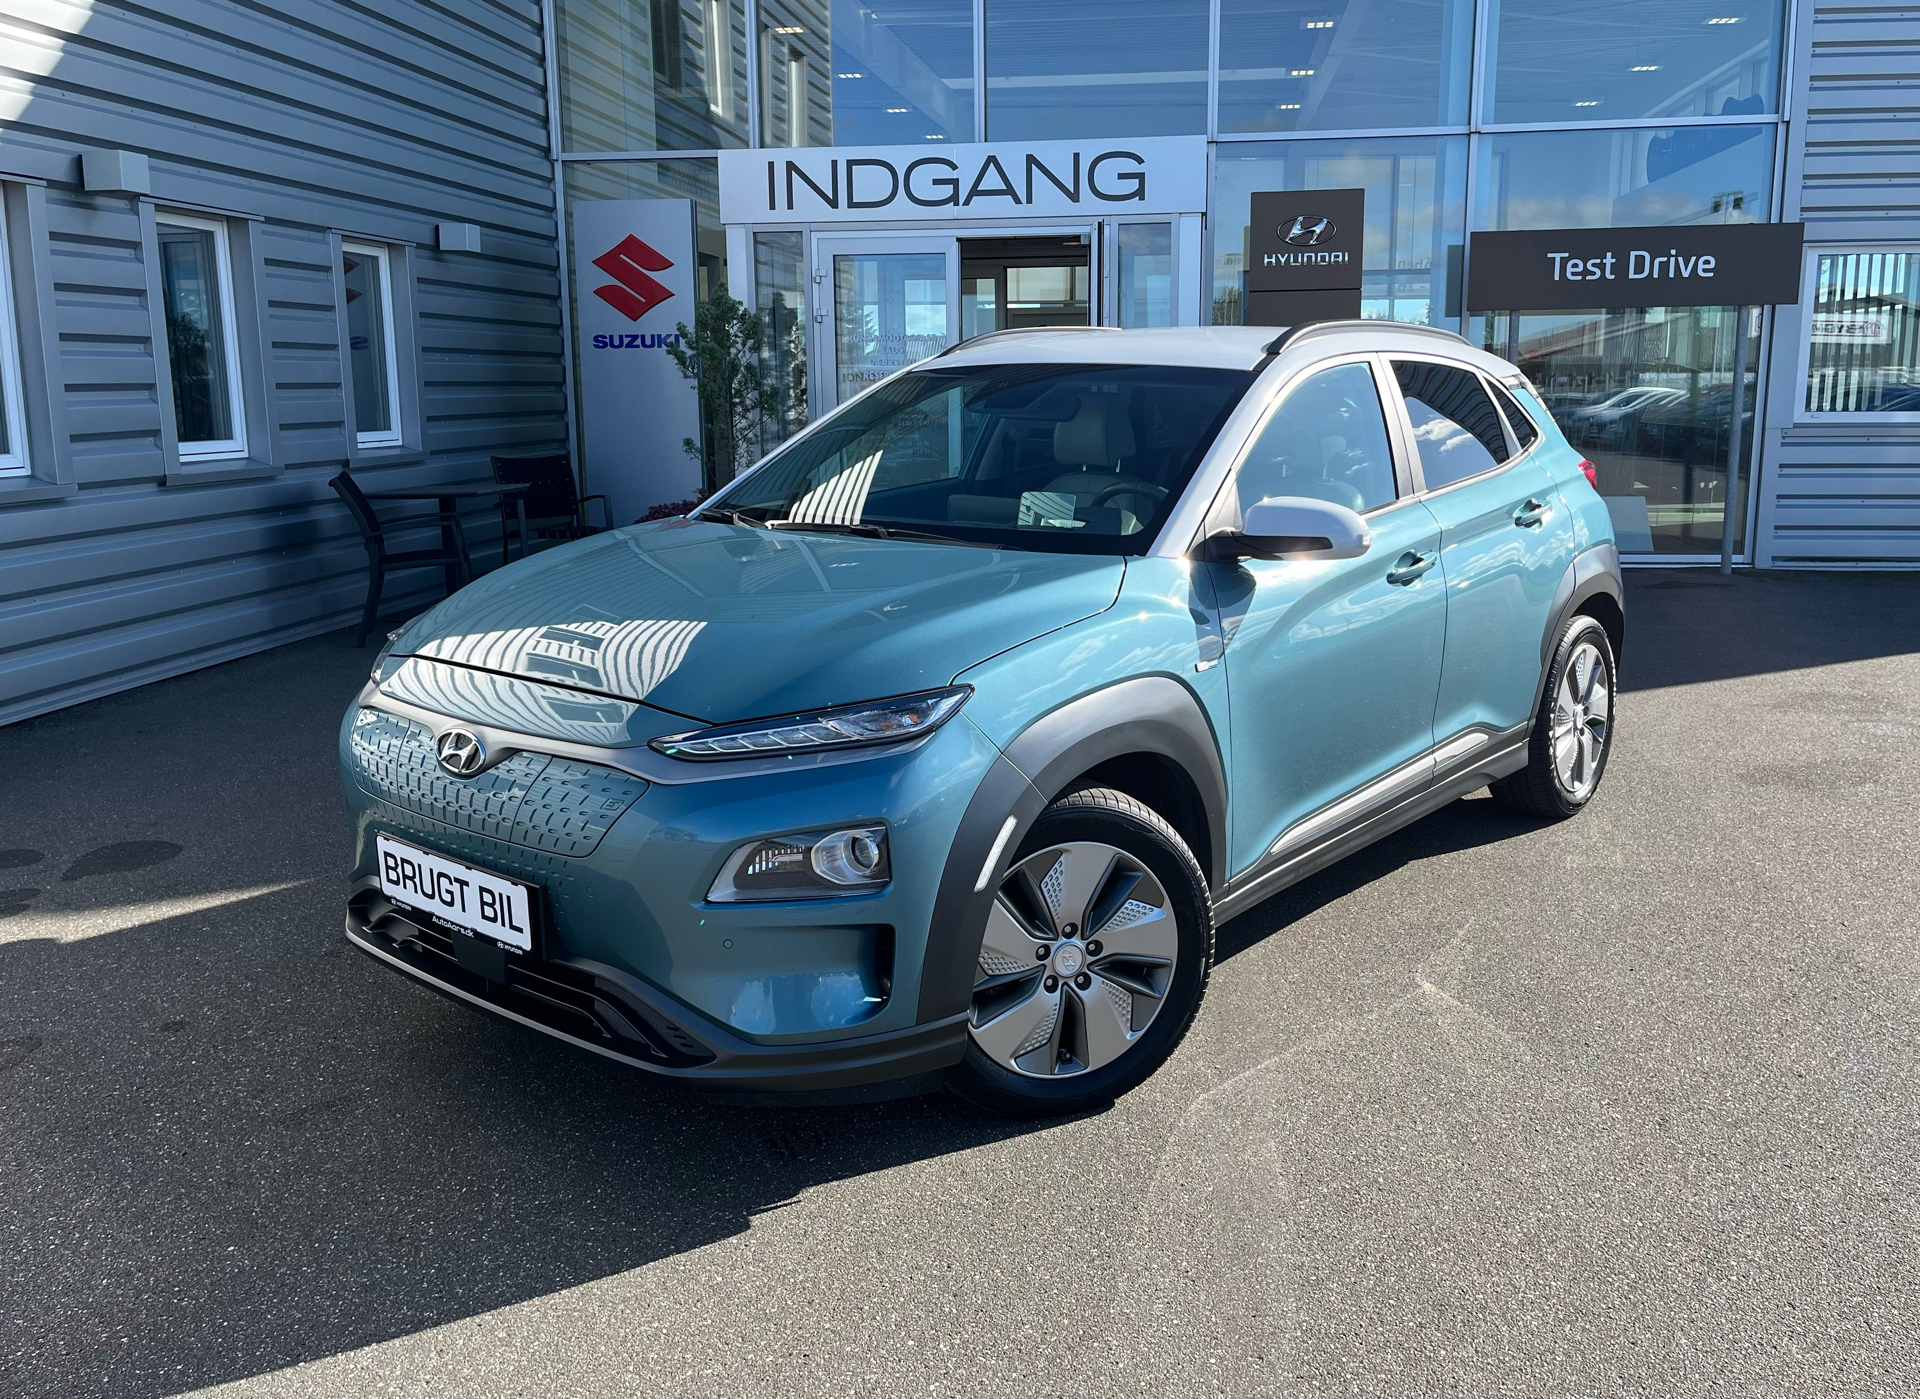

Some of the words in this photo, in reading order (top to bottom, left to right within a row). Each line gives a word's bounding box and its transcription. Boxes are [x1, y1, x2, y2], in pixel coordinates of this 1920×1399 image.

[767, 150, 1147, 211] INDGANG
[1263, 251, 1349, 267] HYUNDAI
[1547, 252, 1616, 282] Test
[1628, 249, 1717, 279] Drive
[383, 850, 470, 913] BRUGT
[478, 885, 524, 934] BIL
